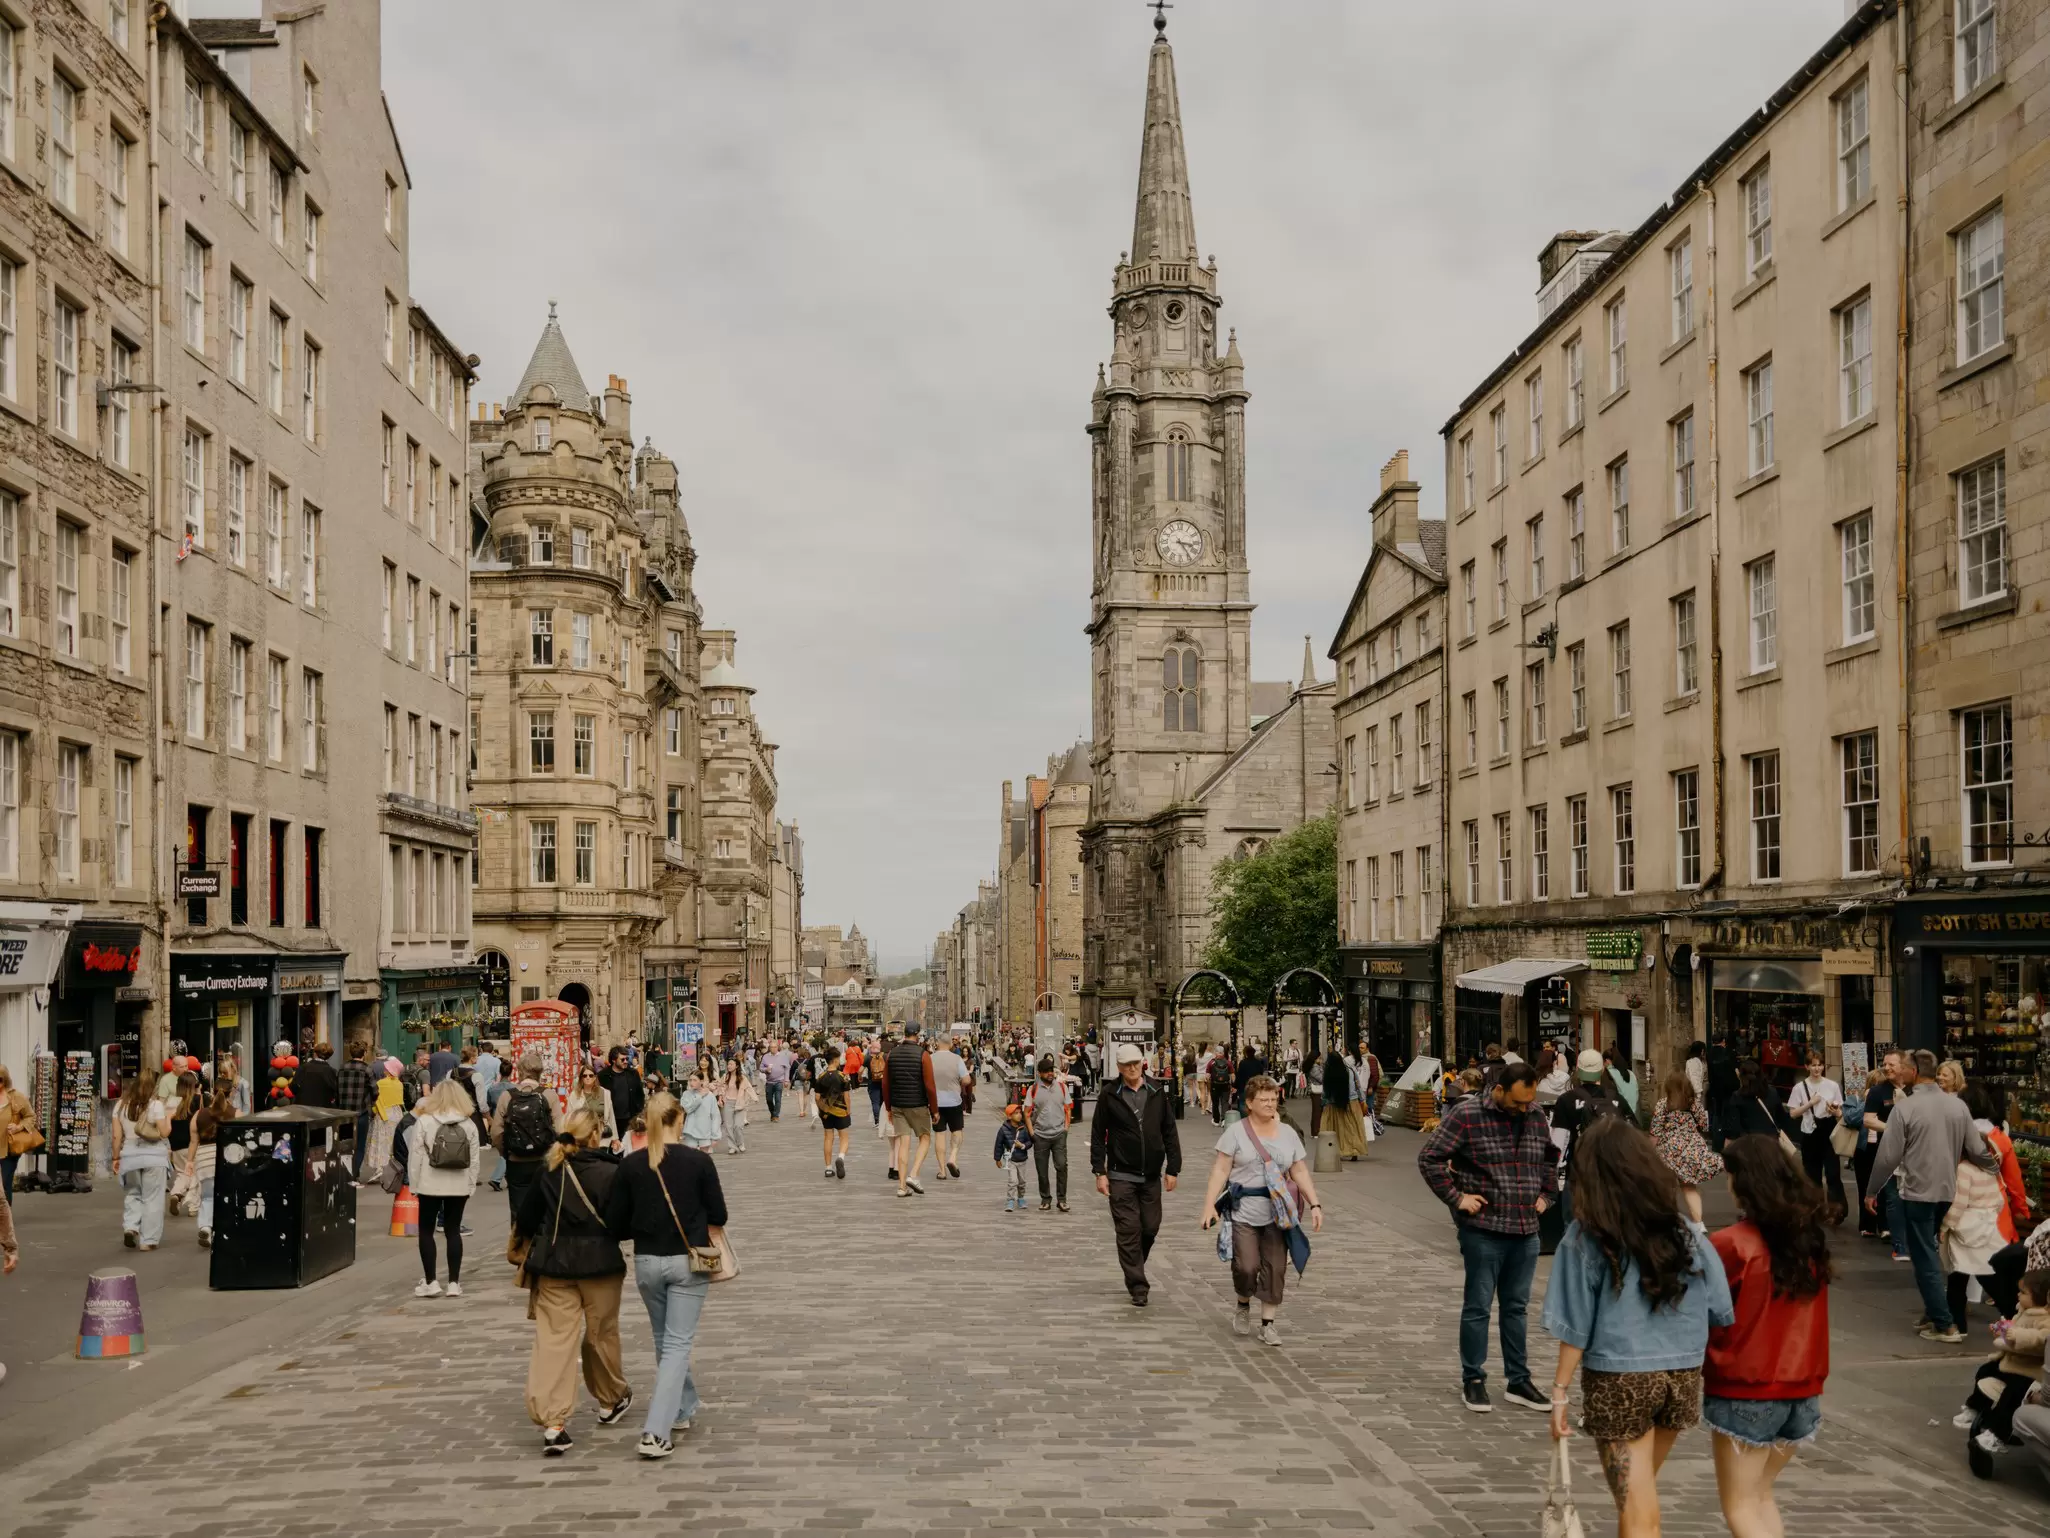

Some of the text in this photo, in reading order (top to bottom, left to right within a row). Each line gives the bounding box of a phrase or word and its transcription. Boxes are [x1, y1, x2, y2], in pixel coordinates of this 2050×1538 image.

[182, 877, 217, 885] Currency
[180, 885, 218, 893] Exchange
[1922, 913, 2000, 931] SCOTTISH
[206, 976, 238, 991] Currency
[237, 975, 268, 989] Exchange
